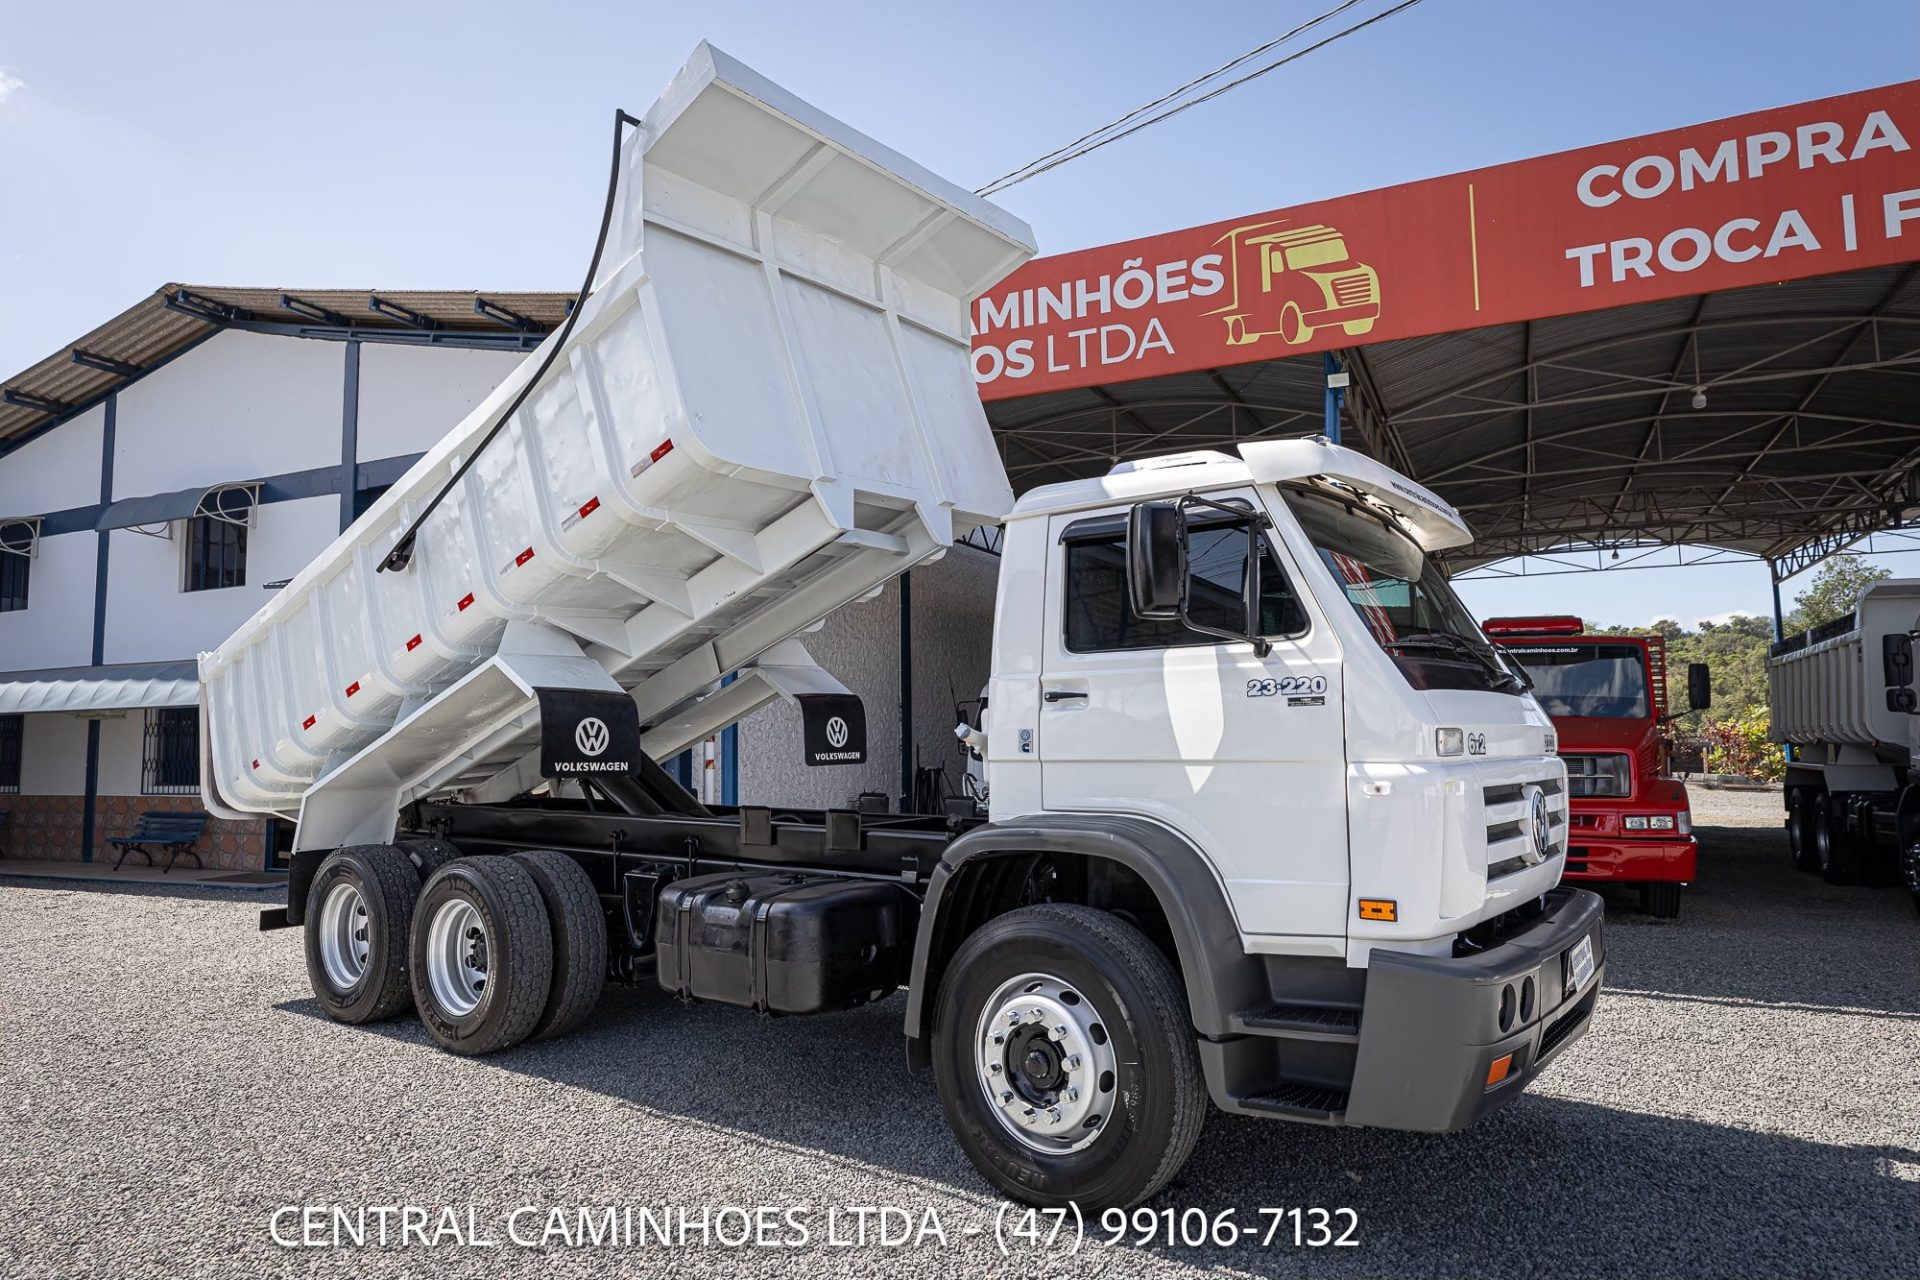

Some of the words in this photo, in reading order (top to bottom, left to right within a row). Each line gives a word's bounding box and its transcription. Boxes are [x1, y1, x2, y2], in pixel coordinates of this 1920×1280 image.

[1576, 109, 1912, 208] COMPRA
[1565, 209, 1822, 288] TROCA
[971, 253, 1225, 337] MINHÕES
[1048, 317, 1176, 373] LTDA
[554, 761, 629, 772] VOLKSWAGEN
[814, 751, 861, 762] VOLKSWAGEN
